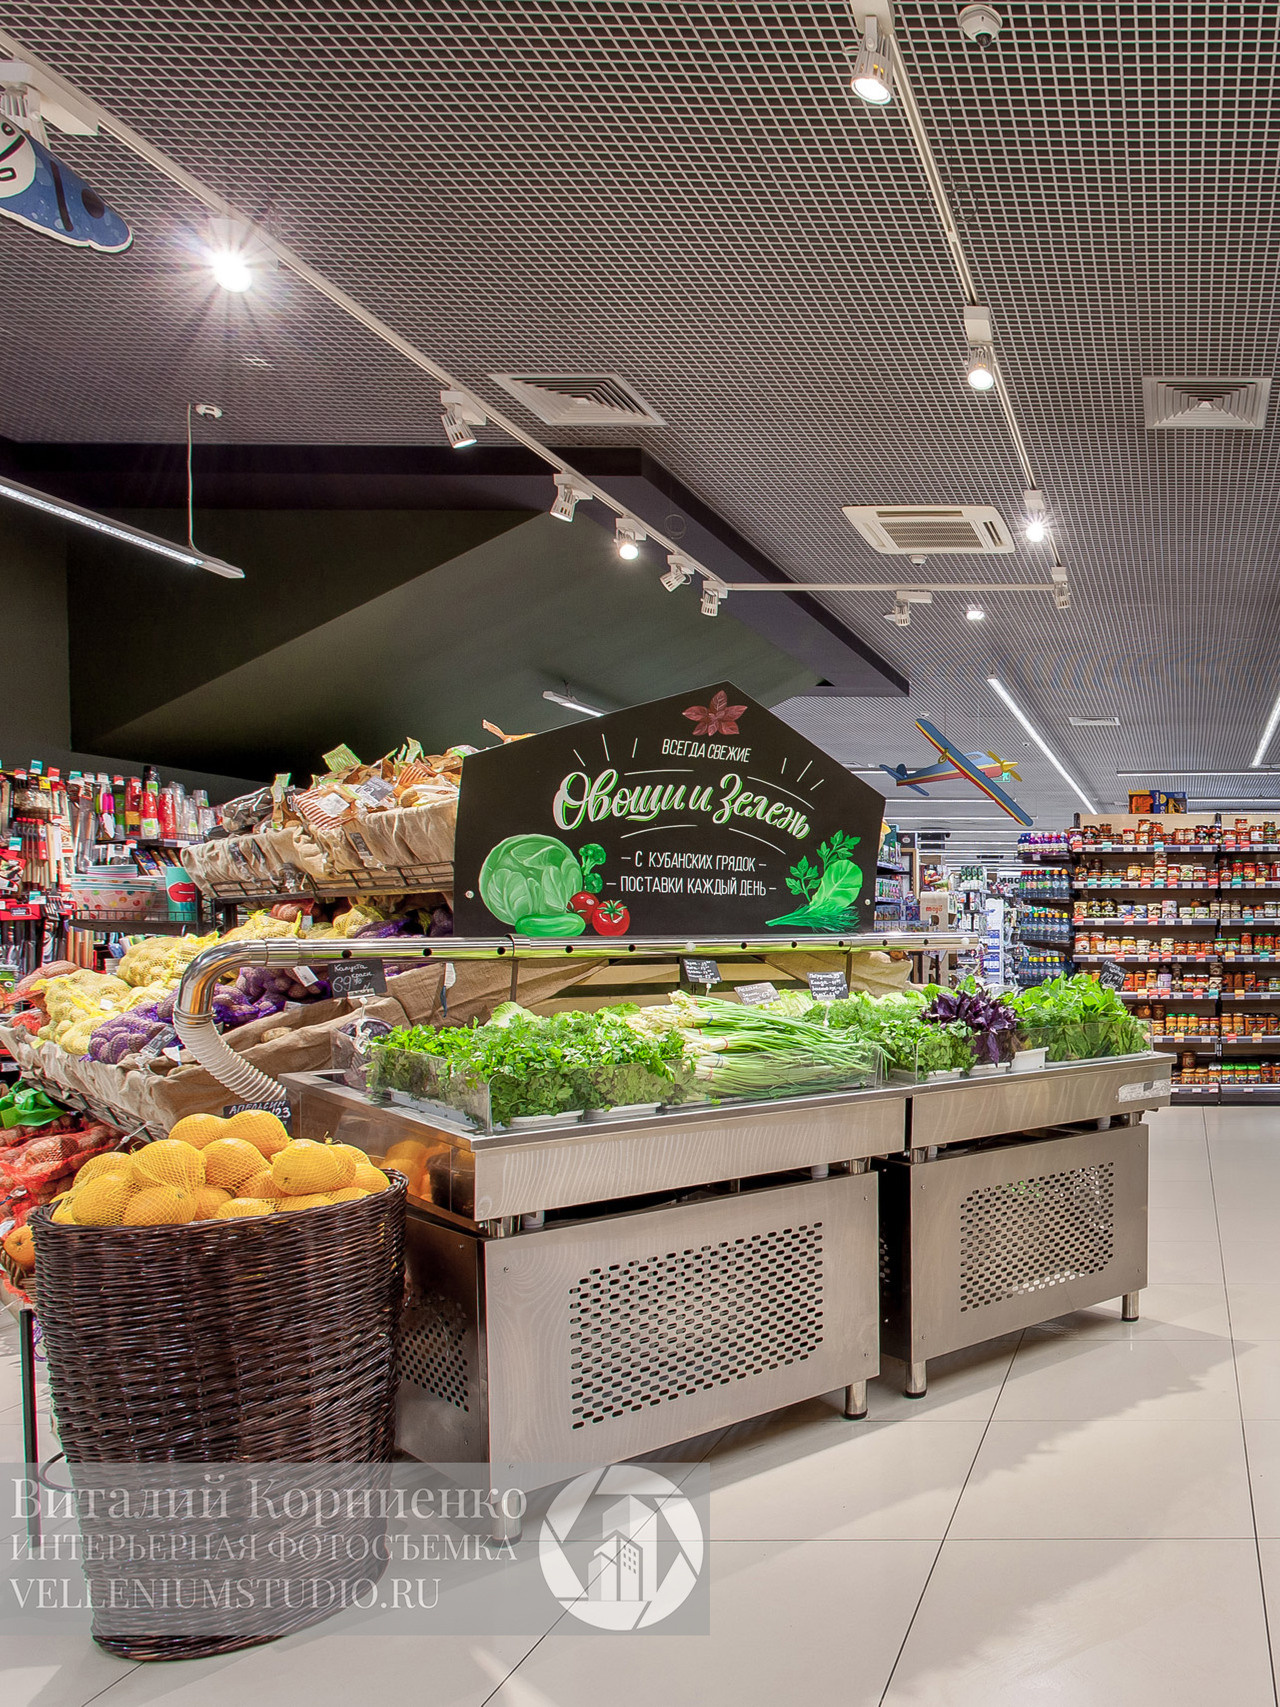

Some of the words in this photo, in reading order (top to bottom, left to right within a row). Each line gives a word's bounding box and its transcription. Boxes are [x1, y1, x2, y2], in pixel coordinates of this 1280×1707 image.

[661, 738, 706, 759] ВСЕГДА
[707, 743, 752, 762] СВЕЖИЕ
[552, 769, 687, 830] Овощи
[688, 786, 714, 812] и
[712, 773, 810, 840] Зелень
[634, 851, 643, 867] С
[648, 852, 712, 870] КУБАНСКИХ
[716, 855, 756, 872] ГРЯДОК
[620, 876, 683, 894] ПОСТАВКИ
[686, 877, 736, 896] КАЖДЫЙ
[738, 880, 766, 896] ДЕНЬ
[334, 964, 368, 973] Капуста
